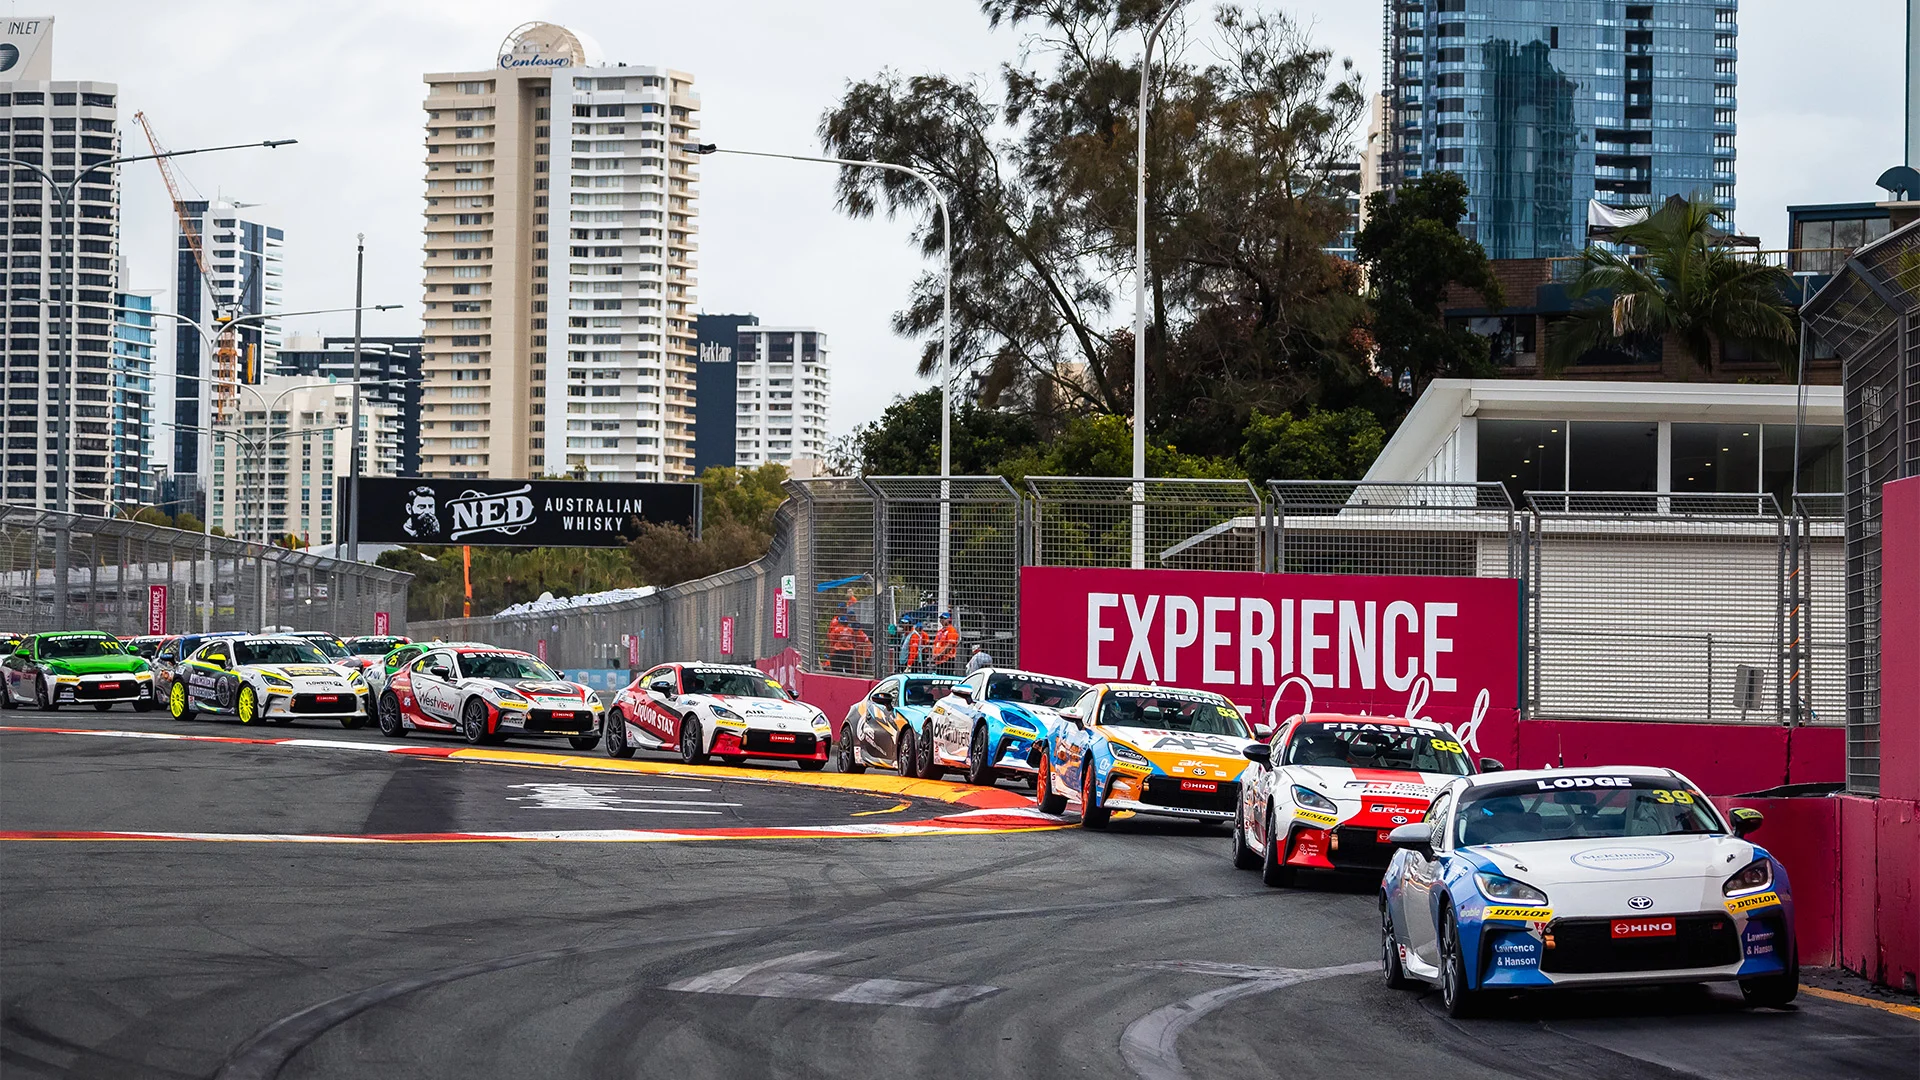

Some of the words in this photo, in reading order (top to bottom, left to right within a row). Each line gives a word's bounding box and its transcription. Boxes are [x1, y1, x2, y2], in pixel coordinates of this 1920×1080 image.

[7, 21, 40, 35] INLET
[500, 54, 569, 69] Contessa
[545, 497, 642, 514] AUSTRALIAN
[451, 495, 535, 531] NED
[563, 516, 623, 531] WHISKY
[100, 641, 119, 650] 117
[1087, 592, 1458, 693] EXPERIENCE
[420, 691, 455, 713] Westview
[1115, 691, 1226, 707] GEOGHEGAN
[634, 699, 657, 727] LIQUOR
[657, 714, 674, 736] STAX
[1216, 706, 1239, 720] 53
[1009, 728, 1036, 739] DUNLOP
[1323, 723, 1436, 737] FRASER
[1430, 739, 1463, 754] 85
[1121, 762, 1152, 773] DUNLOP
[1536, 777, 1632, 790] LODGE
[1652, 789, 1695, 805] 39
[1299, 811, 1337, 823] DUNLOP
[1737, 894, 1777, 909] DUNLOP
[1494, 909, 1551, 918] DUNLOP
[1631, 922, 1673, 932] HINO
[1494, 943, 1535, 953] Lawrence
[1497, 956, 1503, 966] &
[1505, 956, 1537, 967] Hanson
